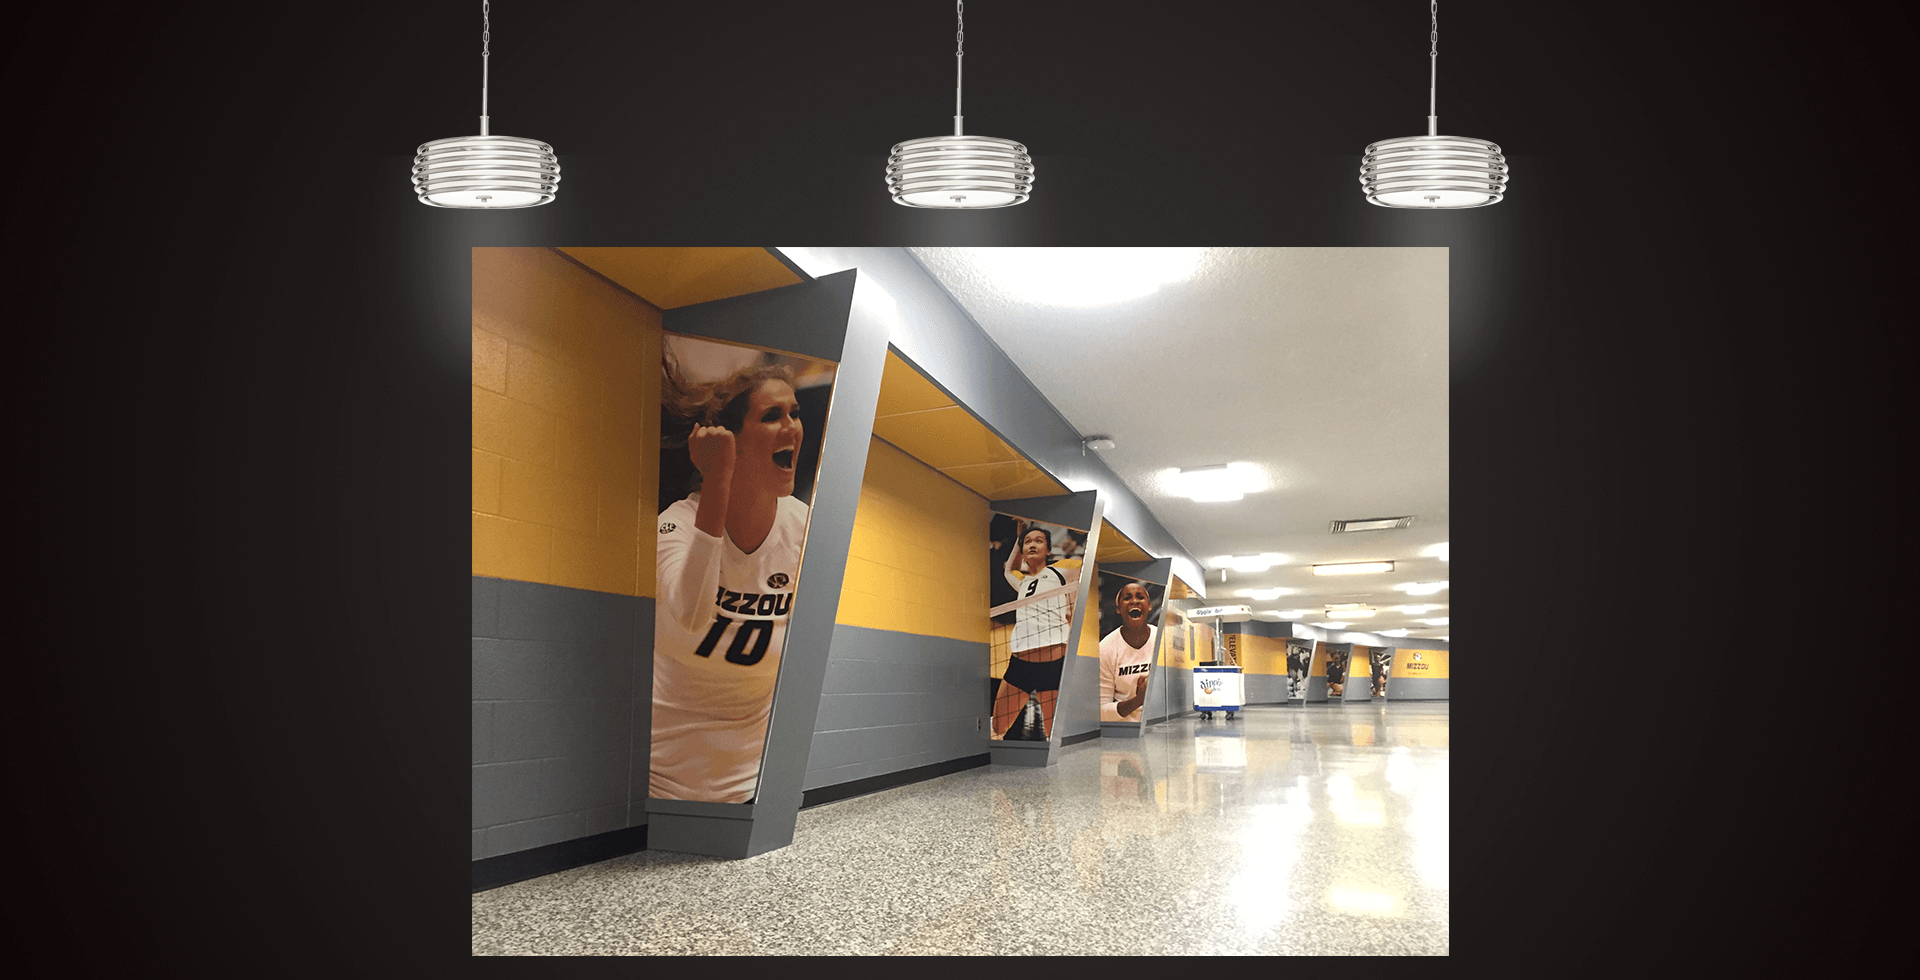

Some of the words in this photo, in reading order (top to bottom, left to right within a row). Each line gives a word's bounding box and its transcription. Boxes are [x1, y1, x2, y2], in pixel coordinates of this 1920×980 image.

[715, 585, 793, 616] IZZOU
[1025, 579, 1038, 598] 9
[694, 613, 774, 667] 10
[1229, 637, 1237, 666] ELEVATO
